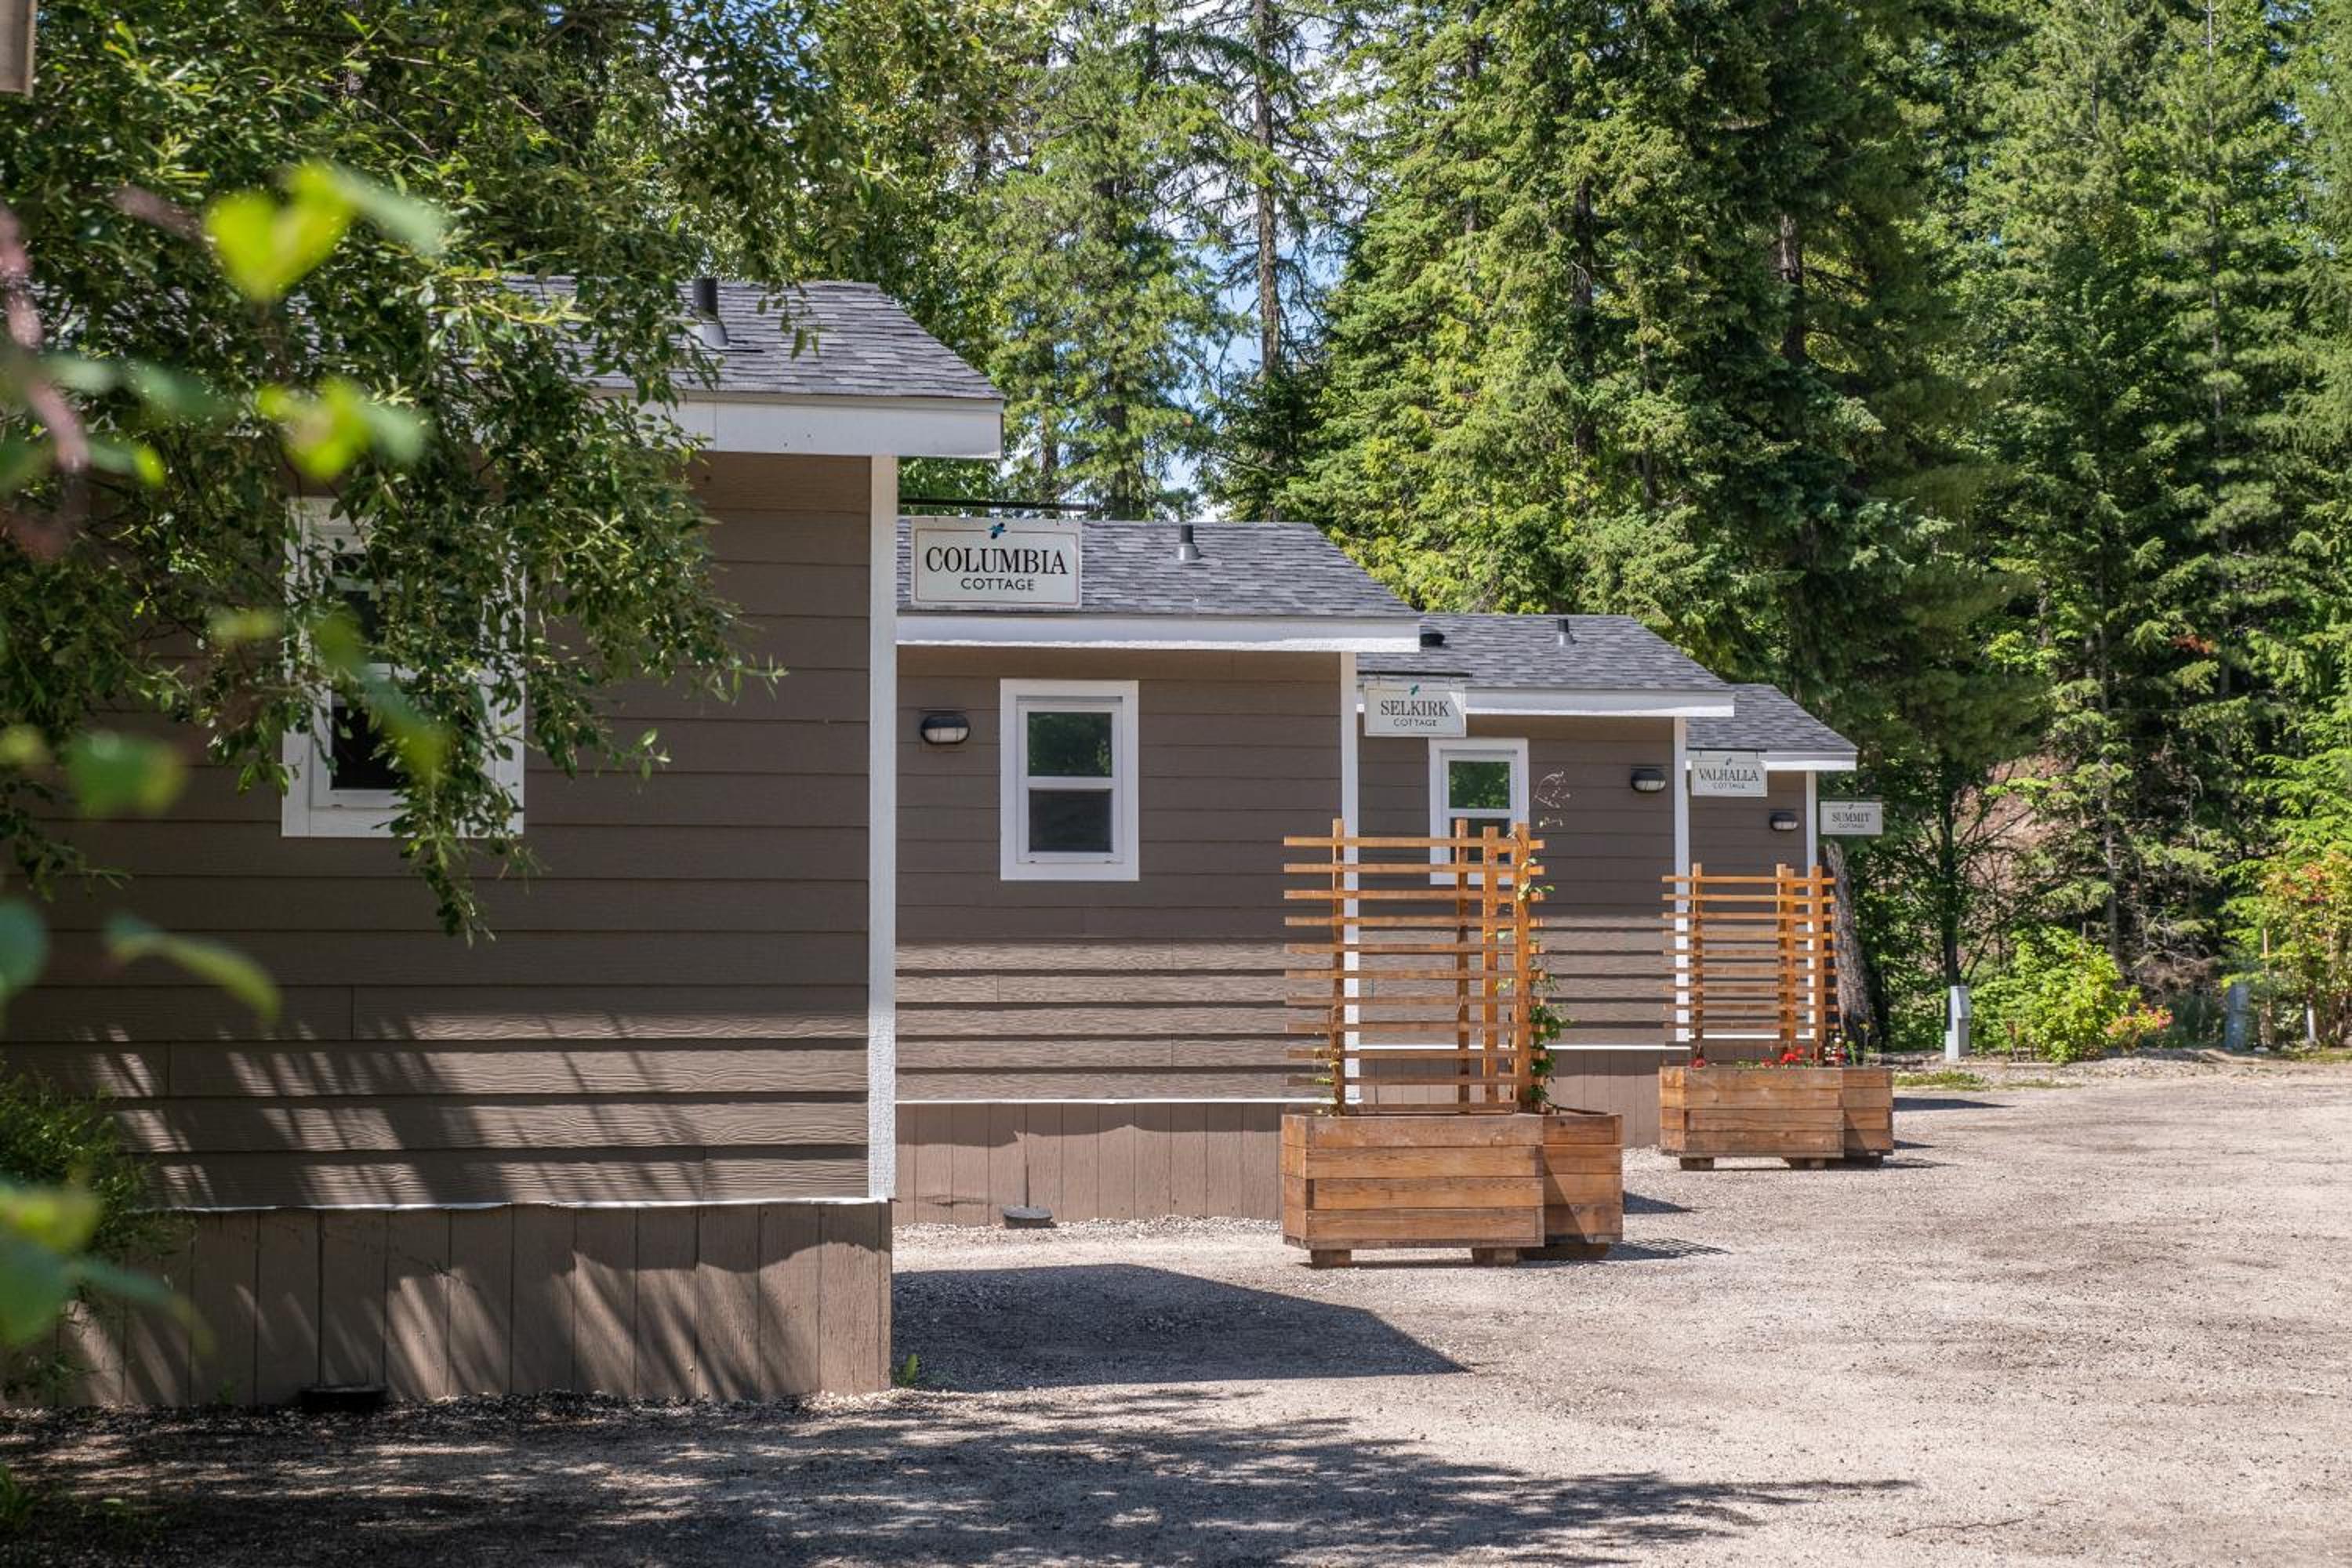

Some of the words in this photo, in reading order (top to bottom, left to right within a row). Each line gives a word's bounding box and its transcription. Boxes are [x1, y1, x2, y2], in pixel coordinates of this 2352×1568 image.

[925, 546, 1068, 575] COLUMBIA
[960, 577, 1035, 591] COTTAGE
[1380, 699, 1450, 717] SELKIRK
[1393, 717, 1437, 727] COTTAGE
[1699, 768, 1759, 782] VALHALLA
[1831, 811, 1871, 822] SUMMIT
